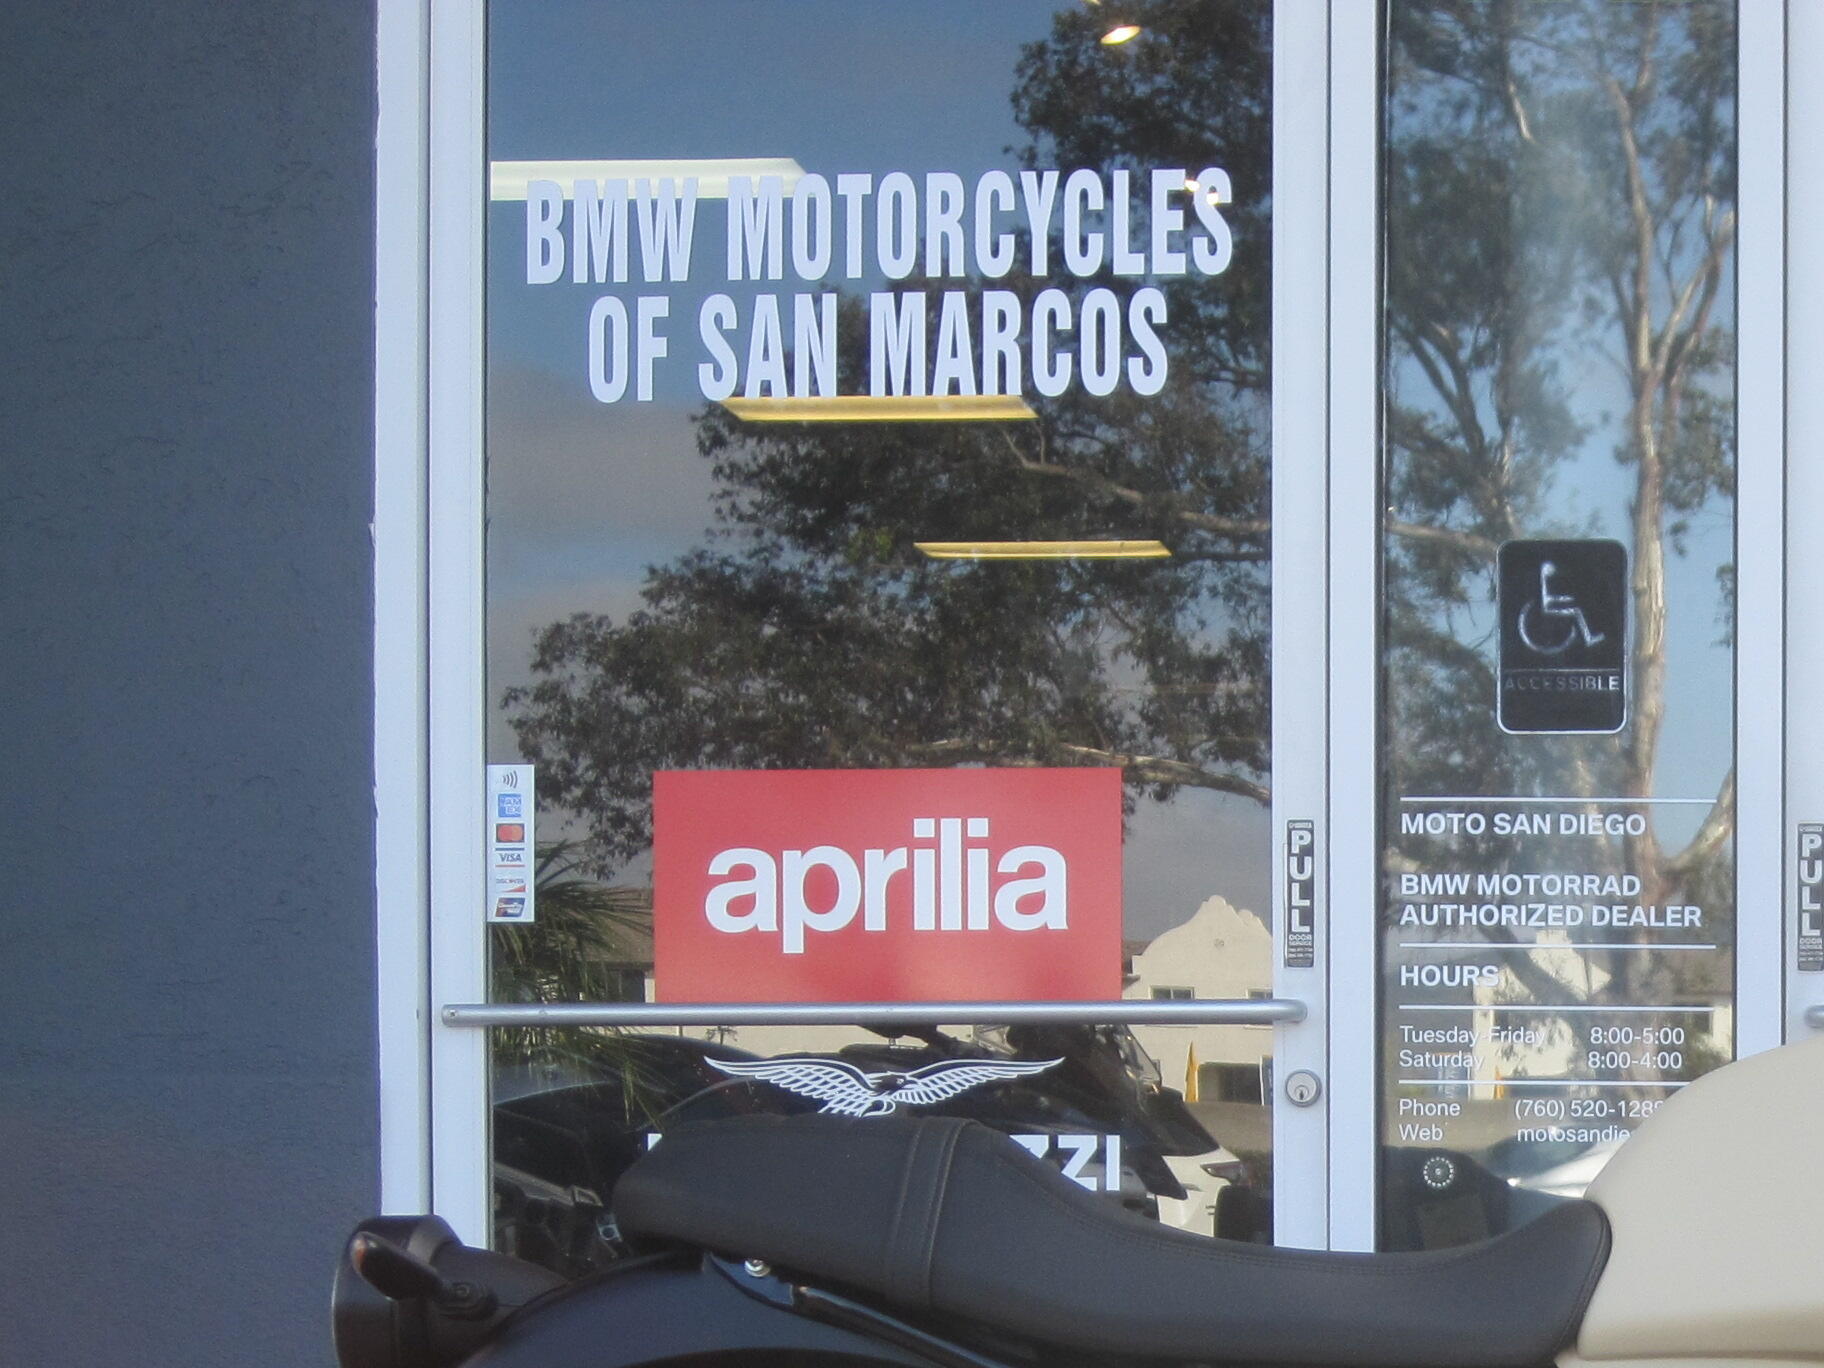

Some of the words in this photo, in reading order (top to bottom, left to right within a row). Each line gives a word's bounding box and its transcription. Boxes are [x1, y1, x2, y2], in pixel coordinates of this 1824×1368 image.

[526, 178, 697, 285] BMW
[727, 167, 1233, 282] MOTORCYCLES
[589, 295, 671, 403] OF
[698, 292, 838, 401] SAN
[870, 287, 1168, 398] MARCOS
[1504, 675, 1620, 691] ACCESSIBLE
[1400, 812, 1486, 835] MOTO
[1493, 812, 1551, 836] SAN
[1559, 813, 1646, 836] DIEGO
[500, 853, 522, 862] VISA
[704, 817, 1069, 955] aprilia
[1289, 829, 1312, 933] PULL
[1400, 873, 1469, 896] BMW
[1477, 873, 1641, 897] MOTORRAD
[1800, 833, 1823, 937] PULL
[1399, 903, 1584, 927] AUTHORIZED
[1592, 905, 1702, 928] DEALER
[1400, 964, 1500, 987] HOURS
[1589, 1026, 1685, 1045] 8:00-5:00
[1399, 1049, 1485, 1071] Saturday
[1587, 1051, 1682, 1069] 8:00-4:00
[1399, 1098, 1461, 1117] Phone
[1514, 1099, 1565, 1121] (760)
[1399, 1123, 1443, 1141] Web
